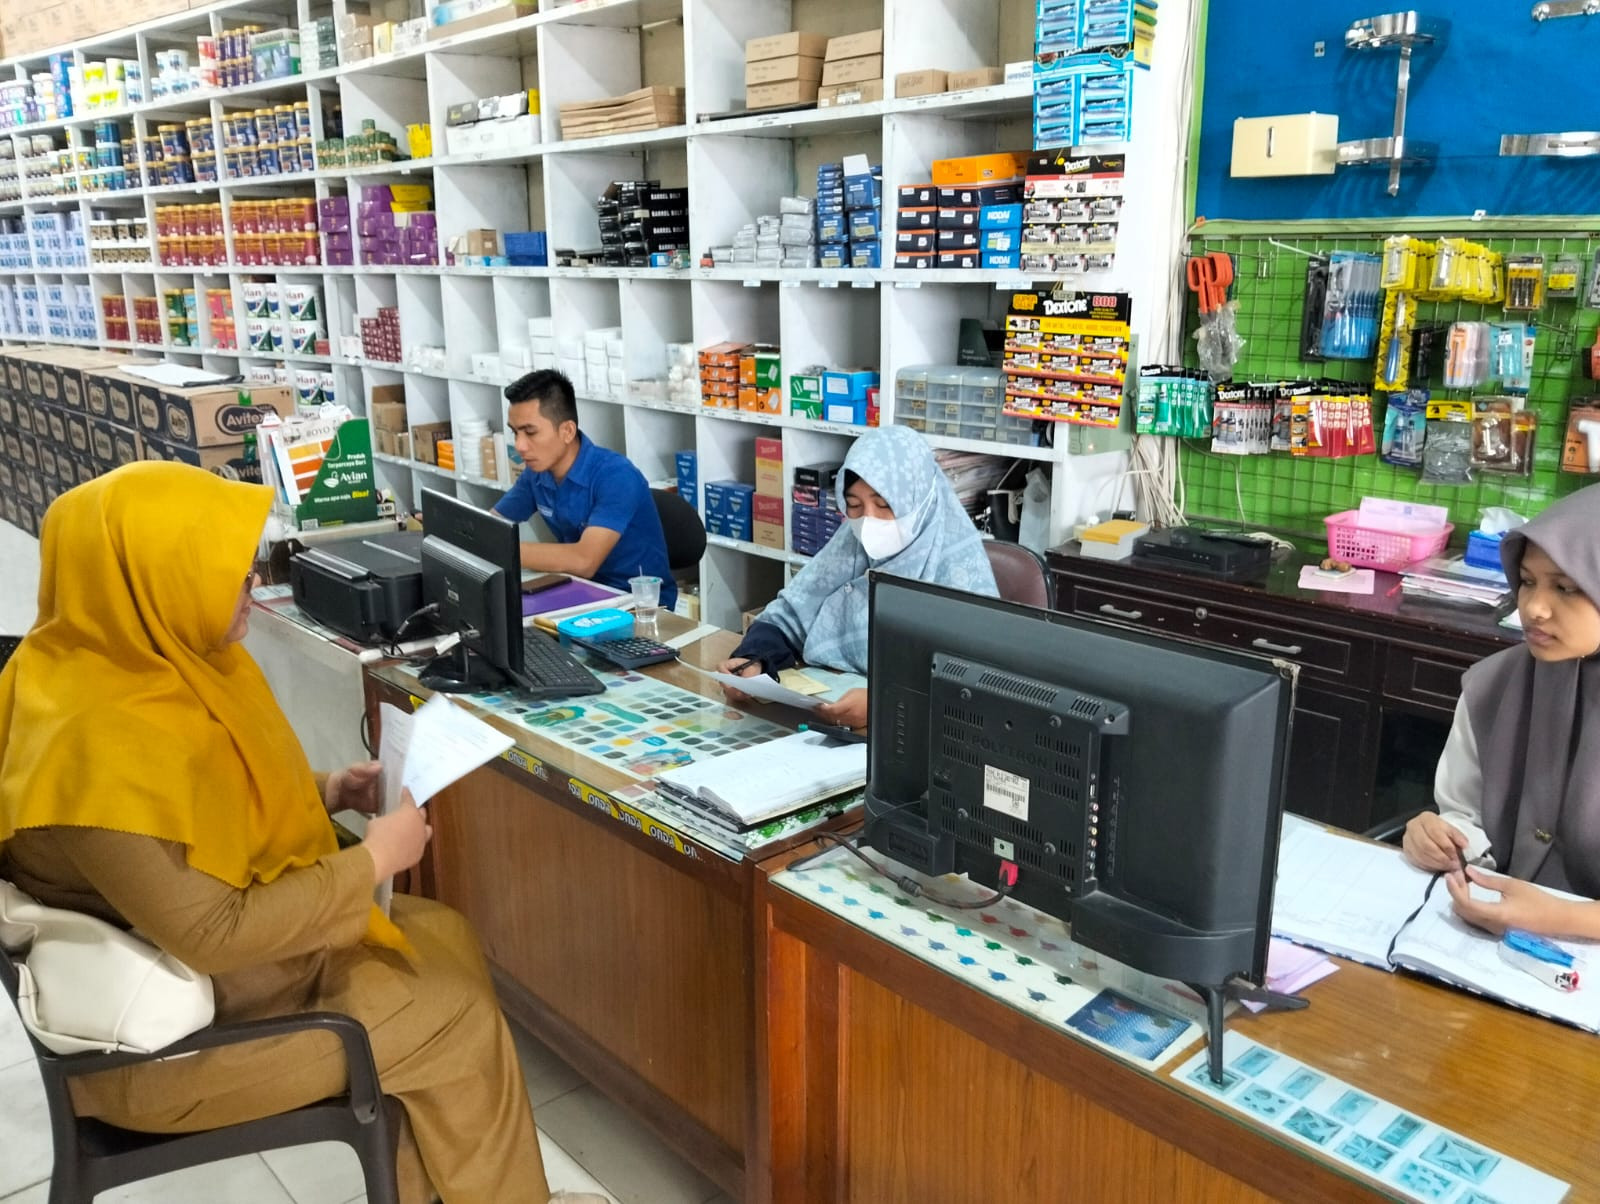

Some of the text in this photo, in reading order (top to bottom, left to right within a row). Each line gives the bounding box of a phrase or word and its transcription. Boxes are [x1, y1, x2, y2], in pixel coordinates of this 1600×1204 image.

[1043, 299, 1087, 315] Dextone
[340, 471, 368, 482] Avian
[972, 735, 1048, 768] POLYTRON
